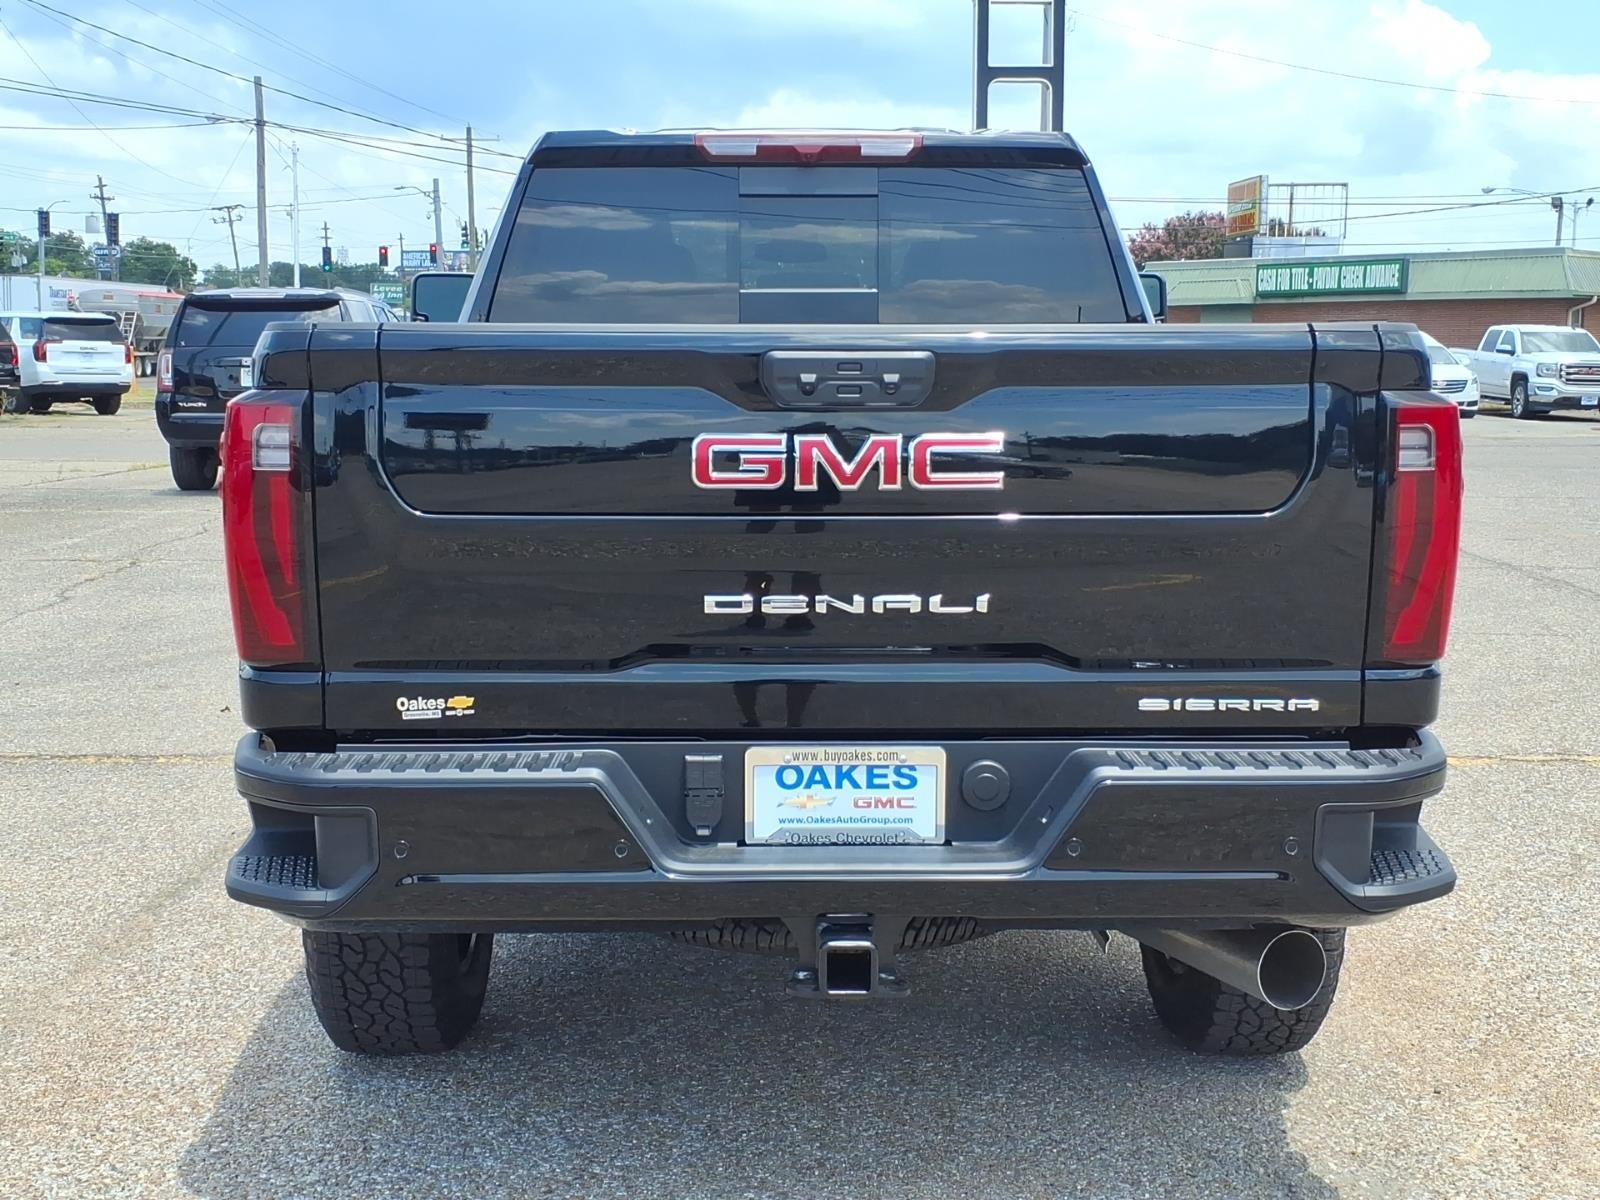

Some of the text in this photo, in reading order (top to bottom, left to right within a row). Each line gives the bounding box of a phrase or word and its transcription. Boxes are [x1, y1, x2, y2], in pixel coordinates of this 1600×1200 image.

[1258, 268, 1277, 291] CASH
[1277, 268, 1290, 290] FOR
[1291, 267, 1309, 290] TITLE
[1313, 266, 1340, 289] PAYDAY
[1341, 265, 1365, 288] CHECK
[1365, 263, 1400, 288] ADVANCE
[691, 431, 1005, 492] GMC
[703, 593, 991, 615] DENALI
[396, 696, 446, 711] Oakes
[1138, 698, 1319, 712] SIERRA
[792, 749, 899, 763] www.buyoakes.com
[775, 764, 918, 790] OAKES
[853, 796, 917, 809] GMC
[778, 815, 913, 825] www.OakesAutoGroup.com
[790, 831, 899, 844] Oakes Chevrolet
